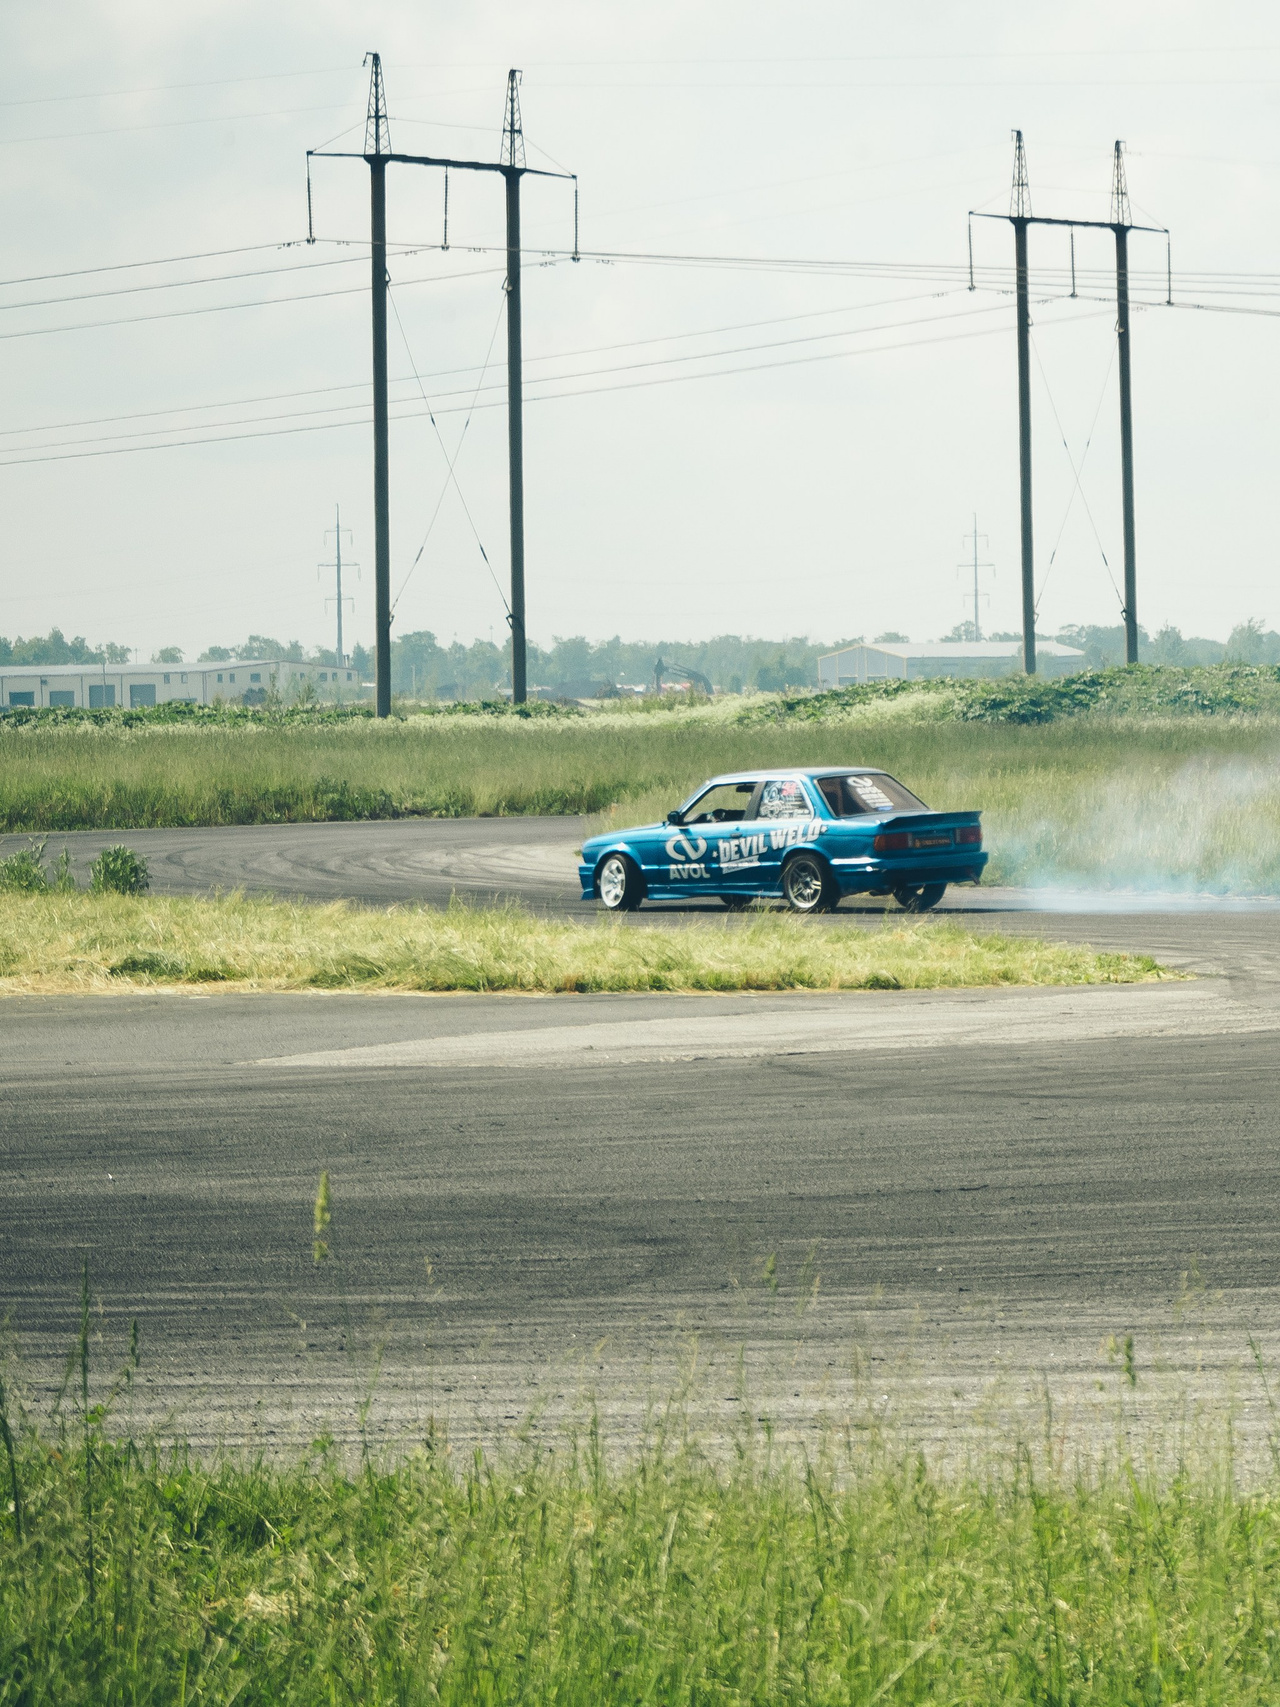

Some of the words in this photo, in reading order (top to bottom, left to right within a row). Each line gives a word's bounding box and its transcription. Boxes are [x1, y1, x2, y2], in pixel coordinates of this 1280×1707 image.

[718, 833, 768, 863] DEVIL
[770, 819, 822, 850] WELD
[669, 863, 710, 880] AVOL
